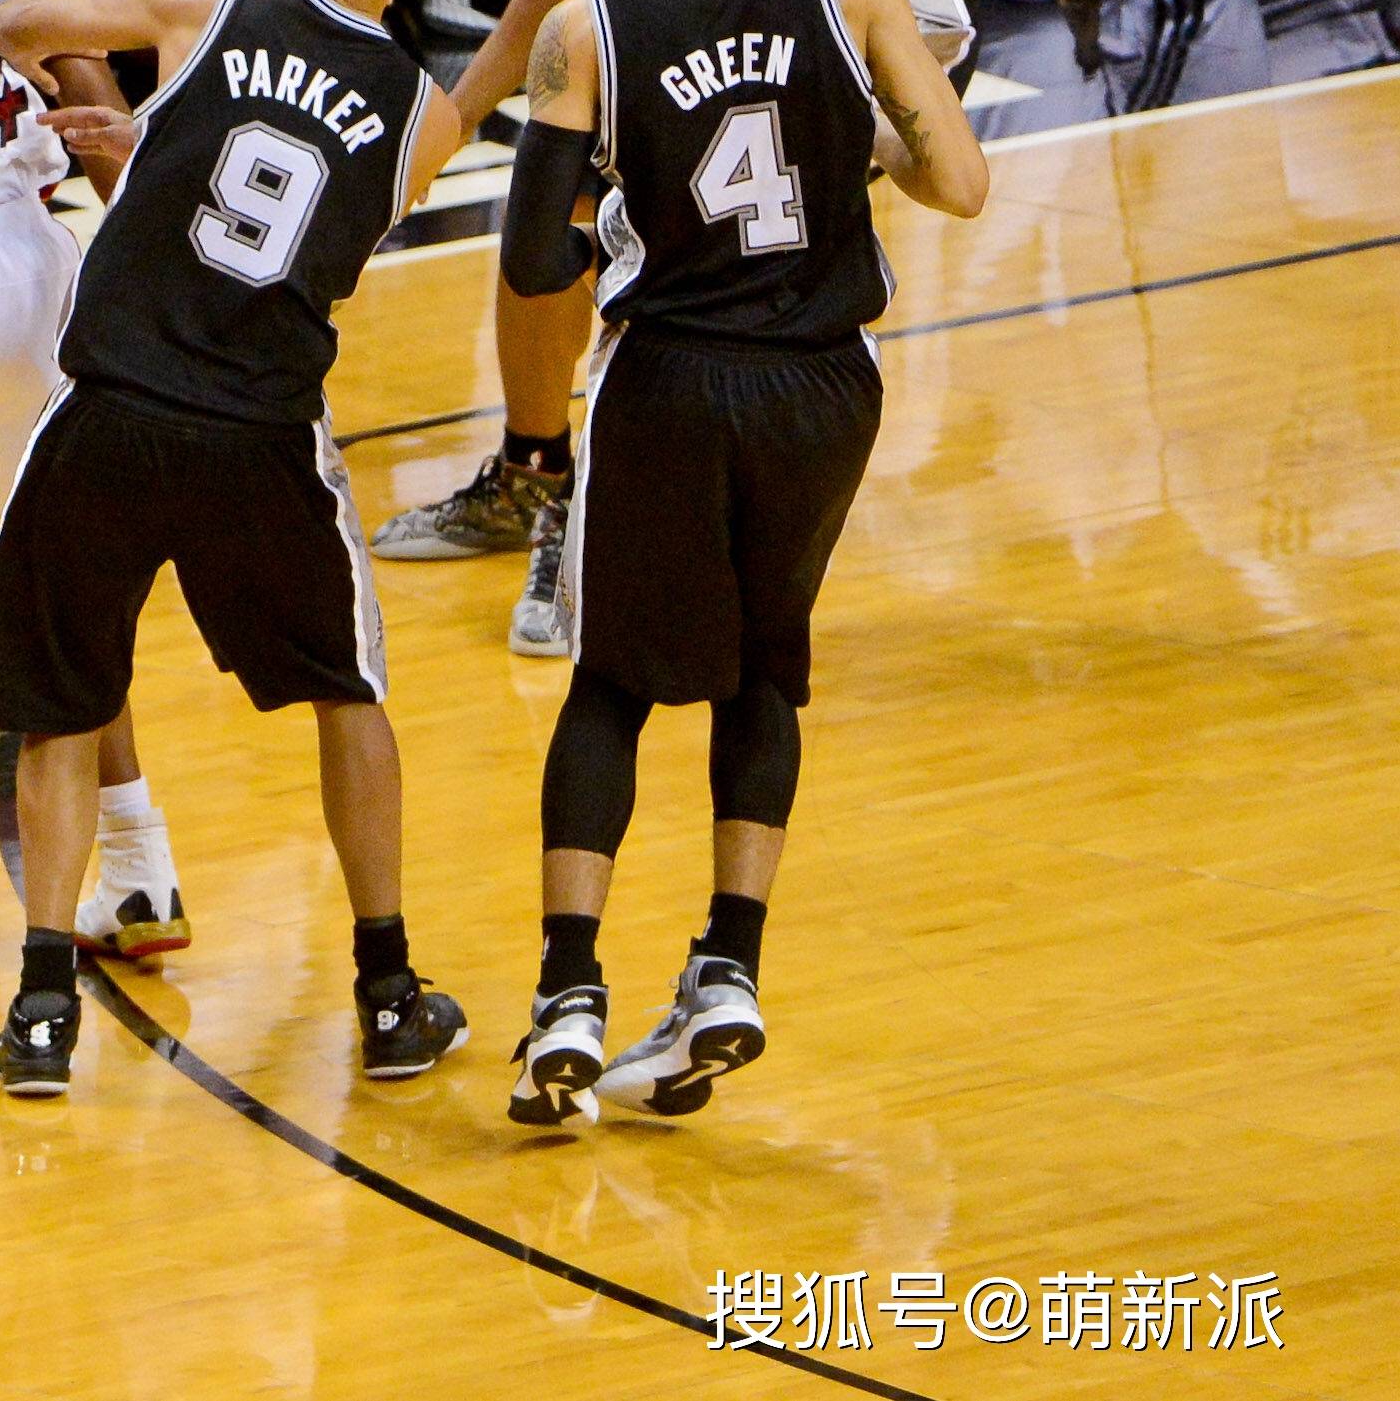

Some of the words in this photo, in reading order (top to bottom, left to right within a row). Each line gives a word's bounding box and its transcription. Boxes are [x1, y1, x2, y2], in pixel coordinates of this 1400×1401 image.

[222, 48, 386, 155] PARKER
[659, 32, 796, 112] GREEN
[188, 120, 331, 289] 9
[689, 100, 809, 257] 4
